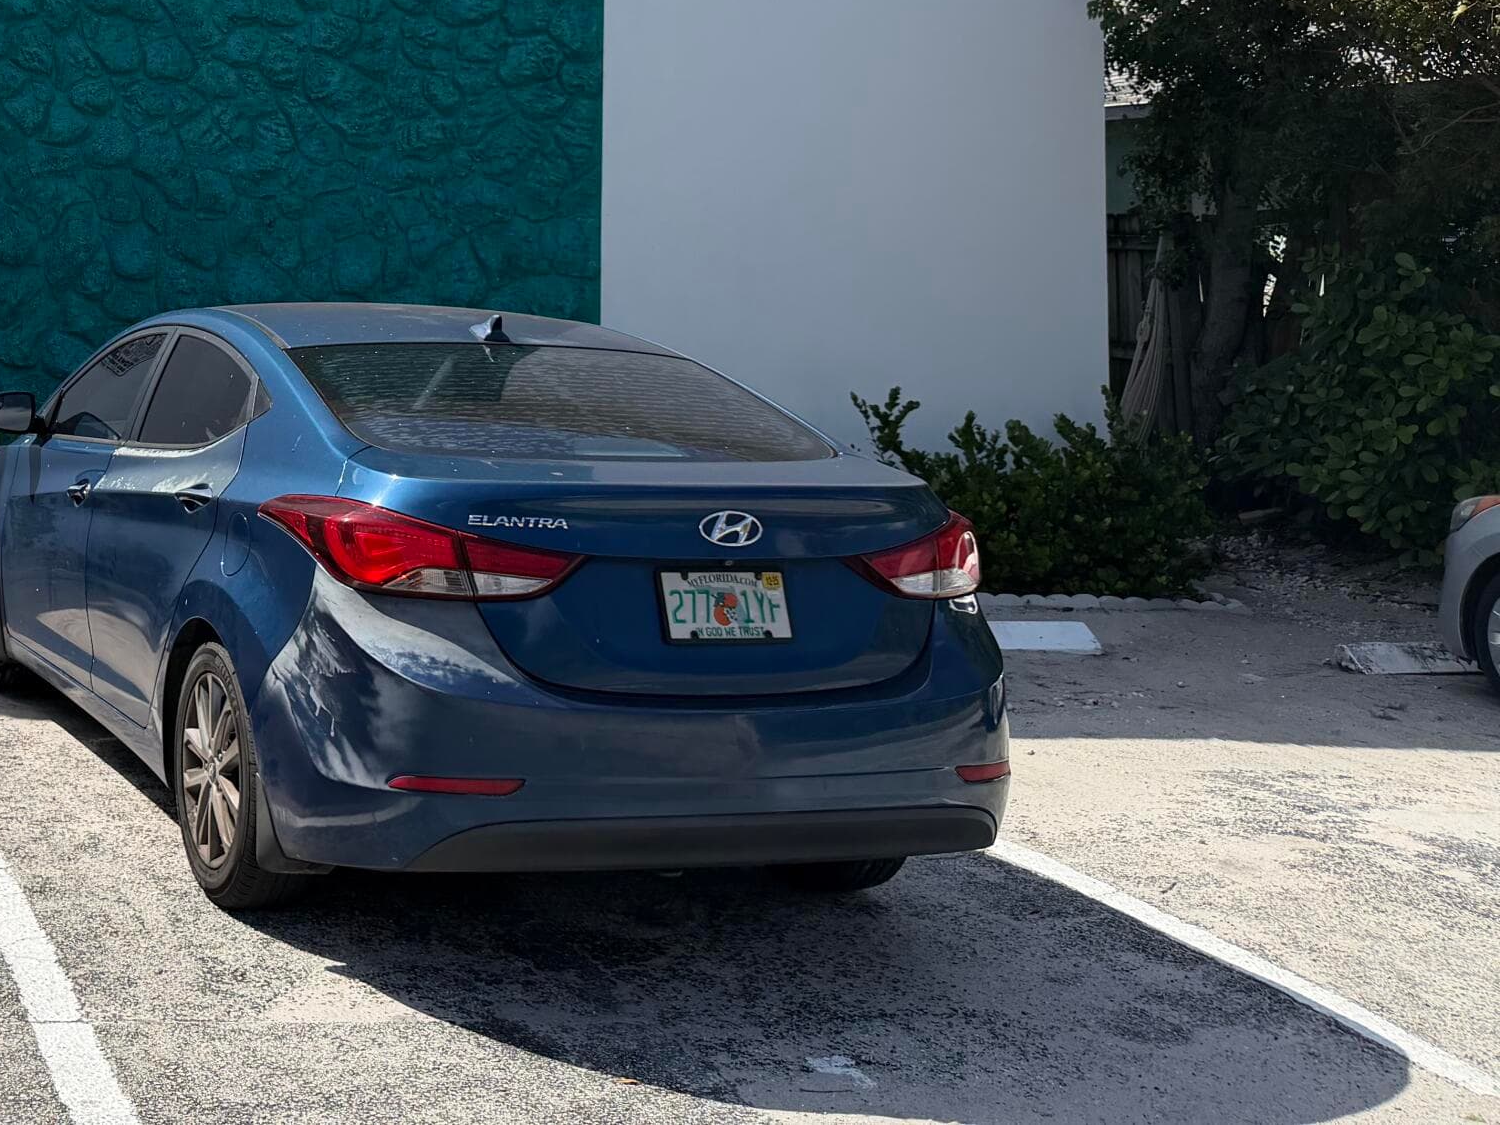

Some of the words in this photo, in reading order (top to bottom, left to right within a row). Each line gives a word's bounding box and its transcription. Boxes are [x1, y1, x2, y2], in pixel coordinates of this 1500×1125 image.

[468, 514, 569, 530] ELANTRA
[687, 573, 759, 588] MYFLORIDA.COM
[669, 588, 711, 624] 277
[705, 627, 723, 637] GOD
[725, 627, 737, 637] WE
[739, 627, 765, 637] TRUST
